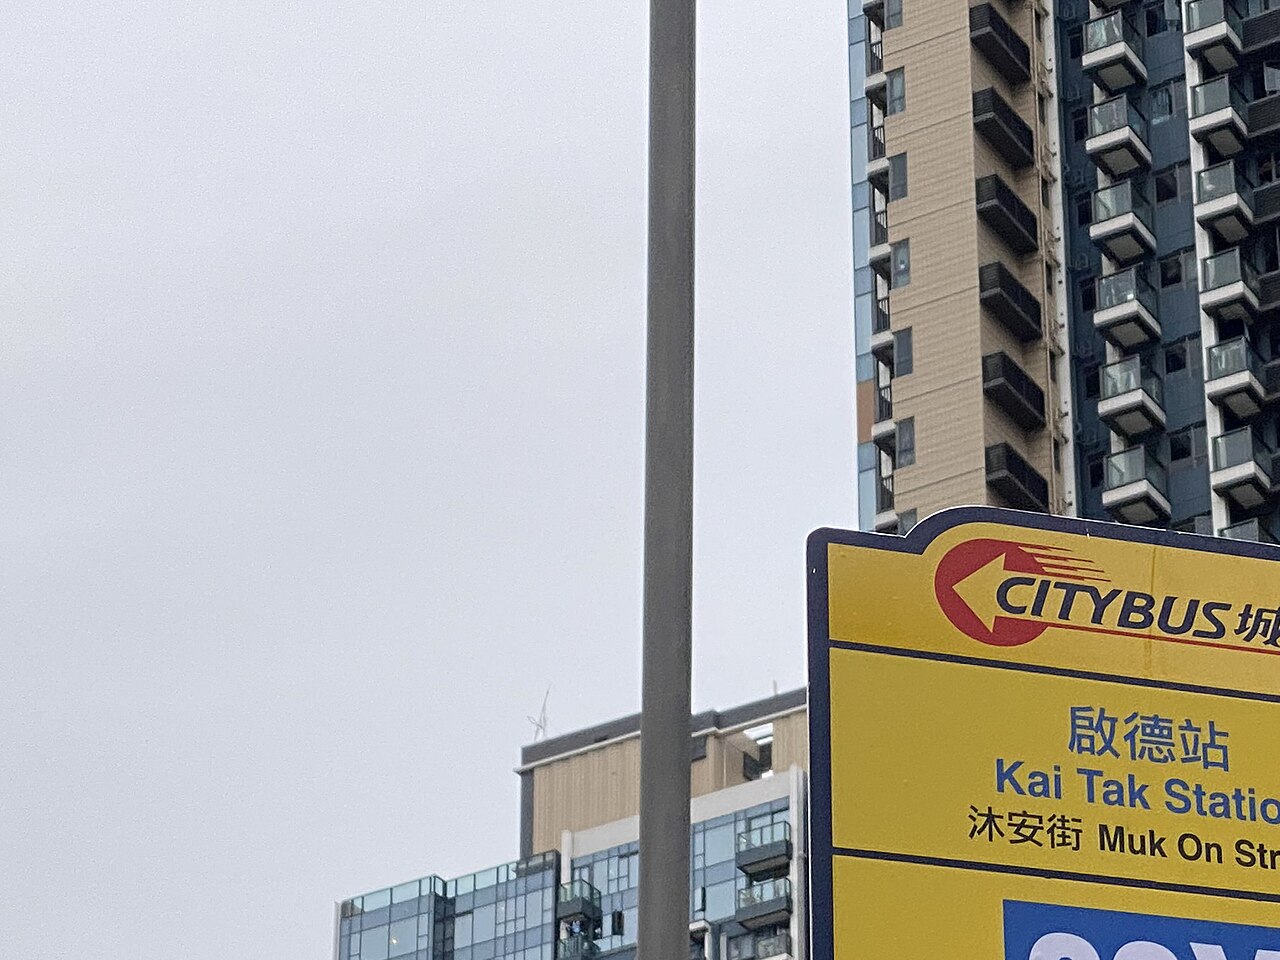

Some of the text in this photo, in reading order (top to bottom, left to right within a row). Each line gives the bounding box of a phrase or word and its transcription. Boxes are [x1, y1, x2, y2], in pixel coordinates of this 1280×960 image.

[996, 576, 1233, 641] CITYBUS
[1068, 705, 1229, 772] 啟德站
[995, 758, 1062, 800] Kai
[1076, 767, 1151, 810] Tak
[967, 804, 1083, 852] 沐安街
[1098, 823, 1168, 858] Muk
[1177, 833, 1223, 864] On
